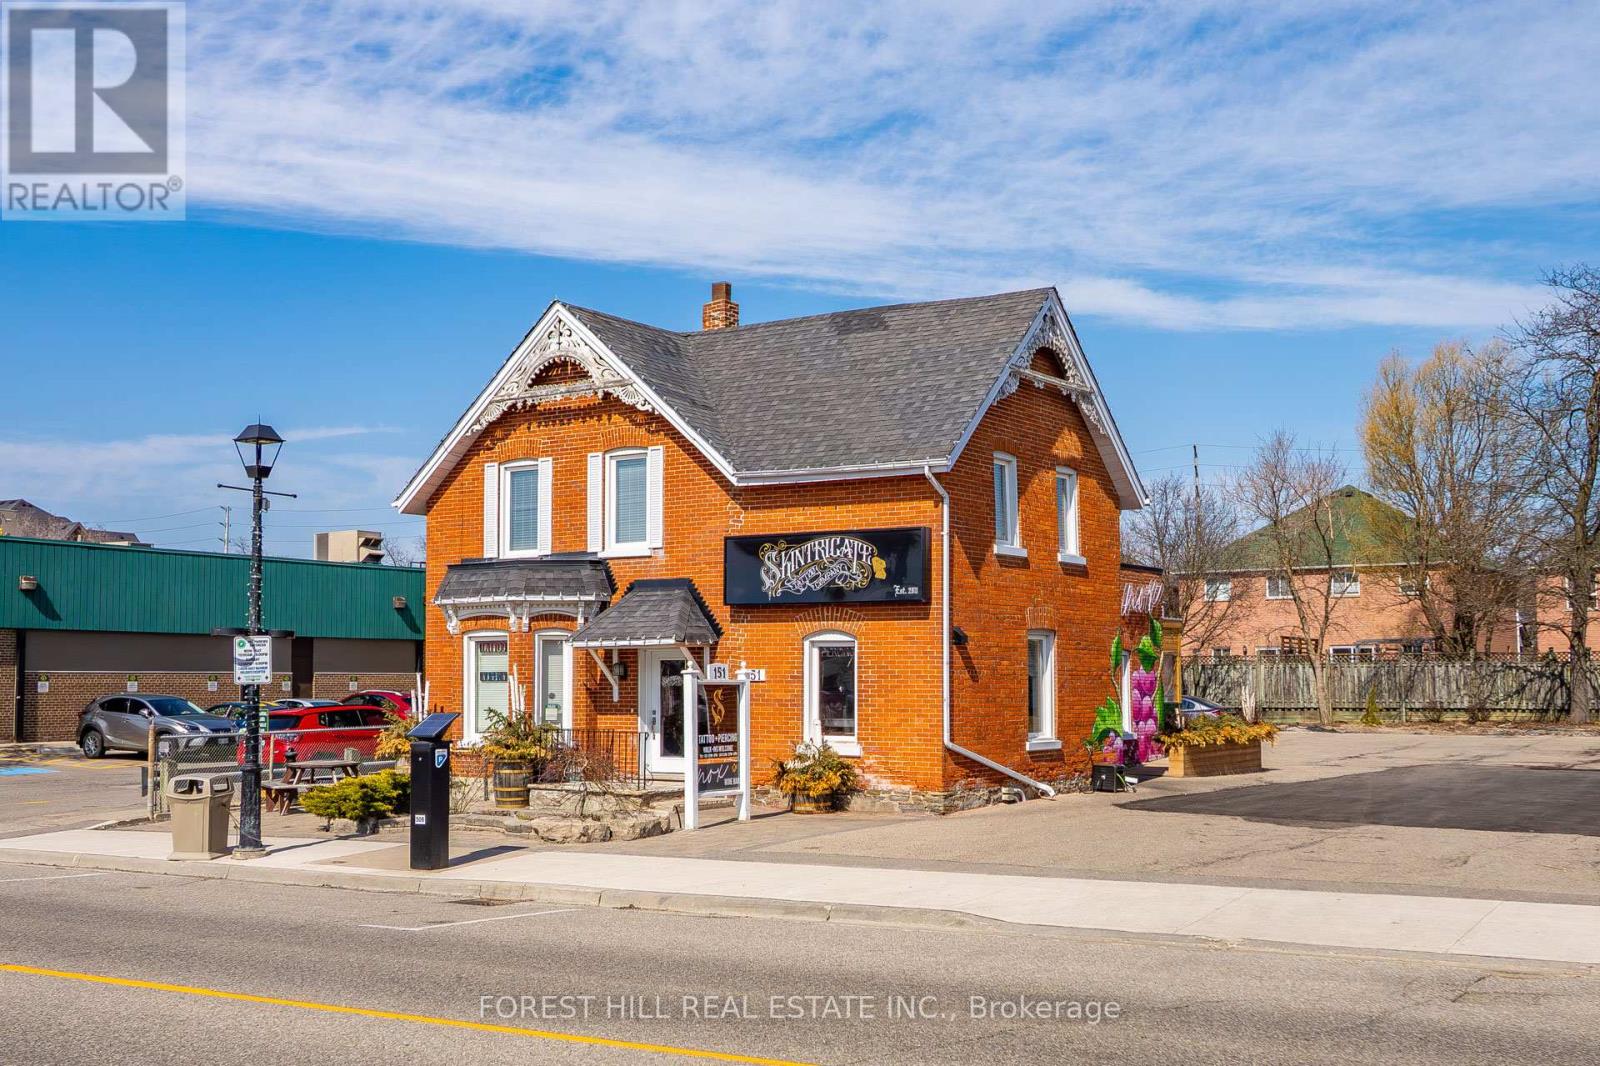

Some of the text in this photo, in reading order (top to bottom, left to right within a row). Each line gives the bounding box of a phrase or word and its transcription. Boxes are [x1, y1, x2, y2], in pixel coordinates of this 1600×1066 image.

[760, 537, 873, 593] SKINTRICATE
[713, 666, 726, 680] 151
[698, 734, 715, 745] TATTOO
